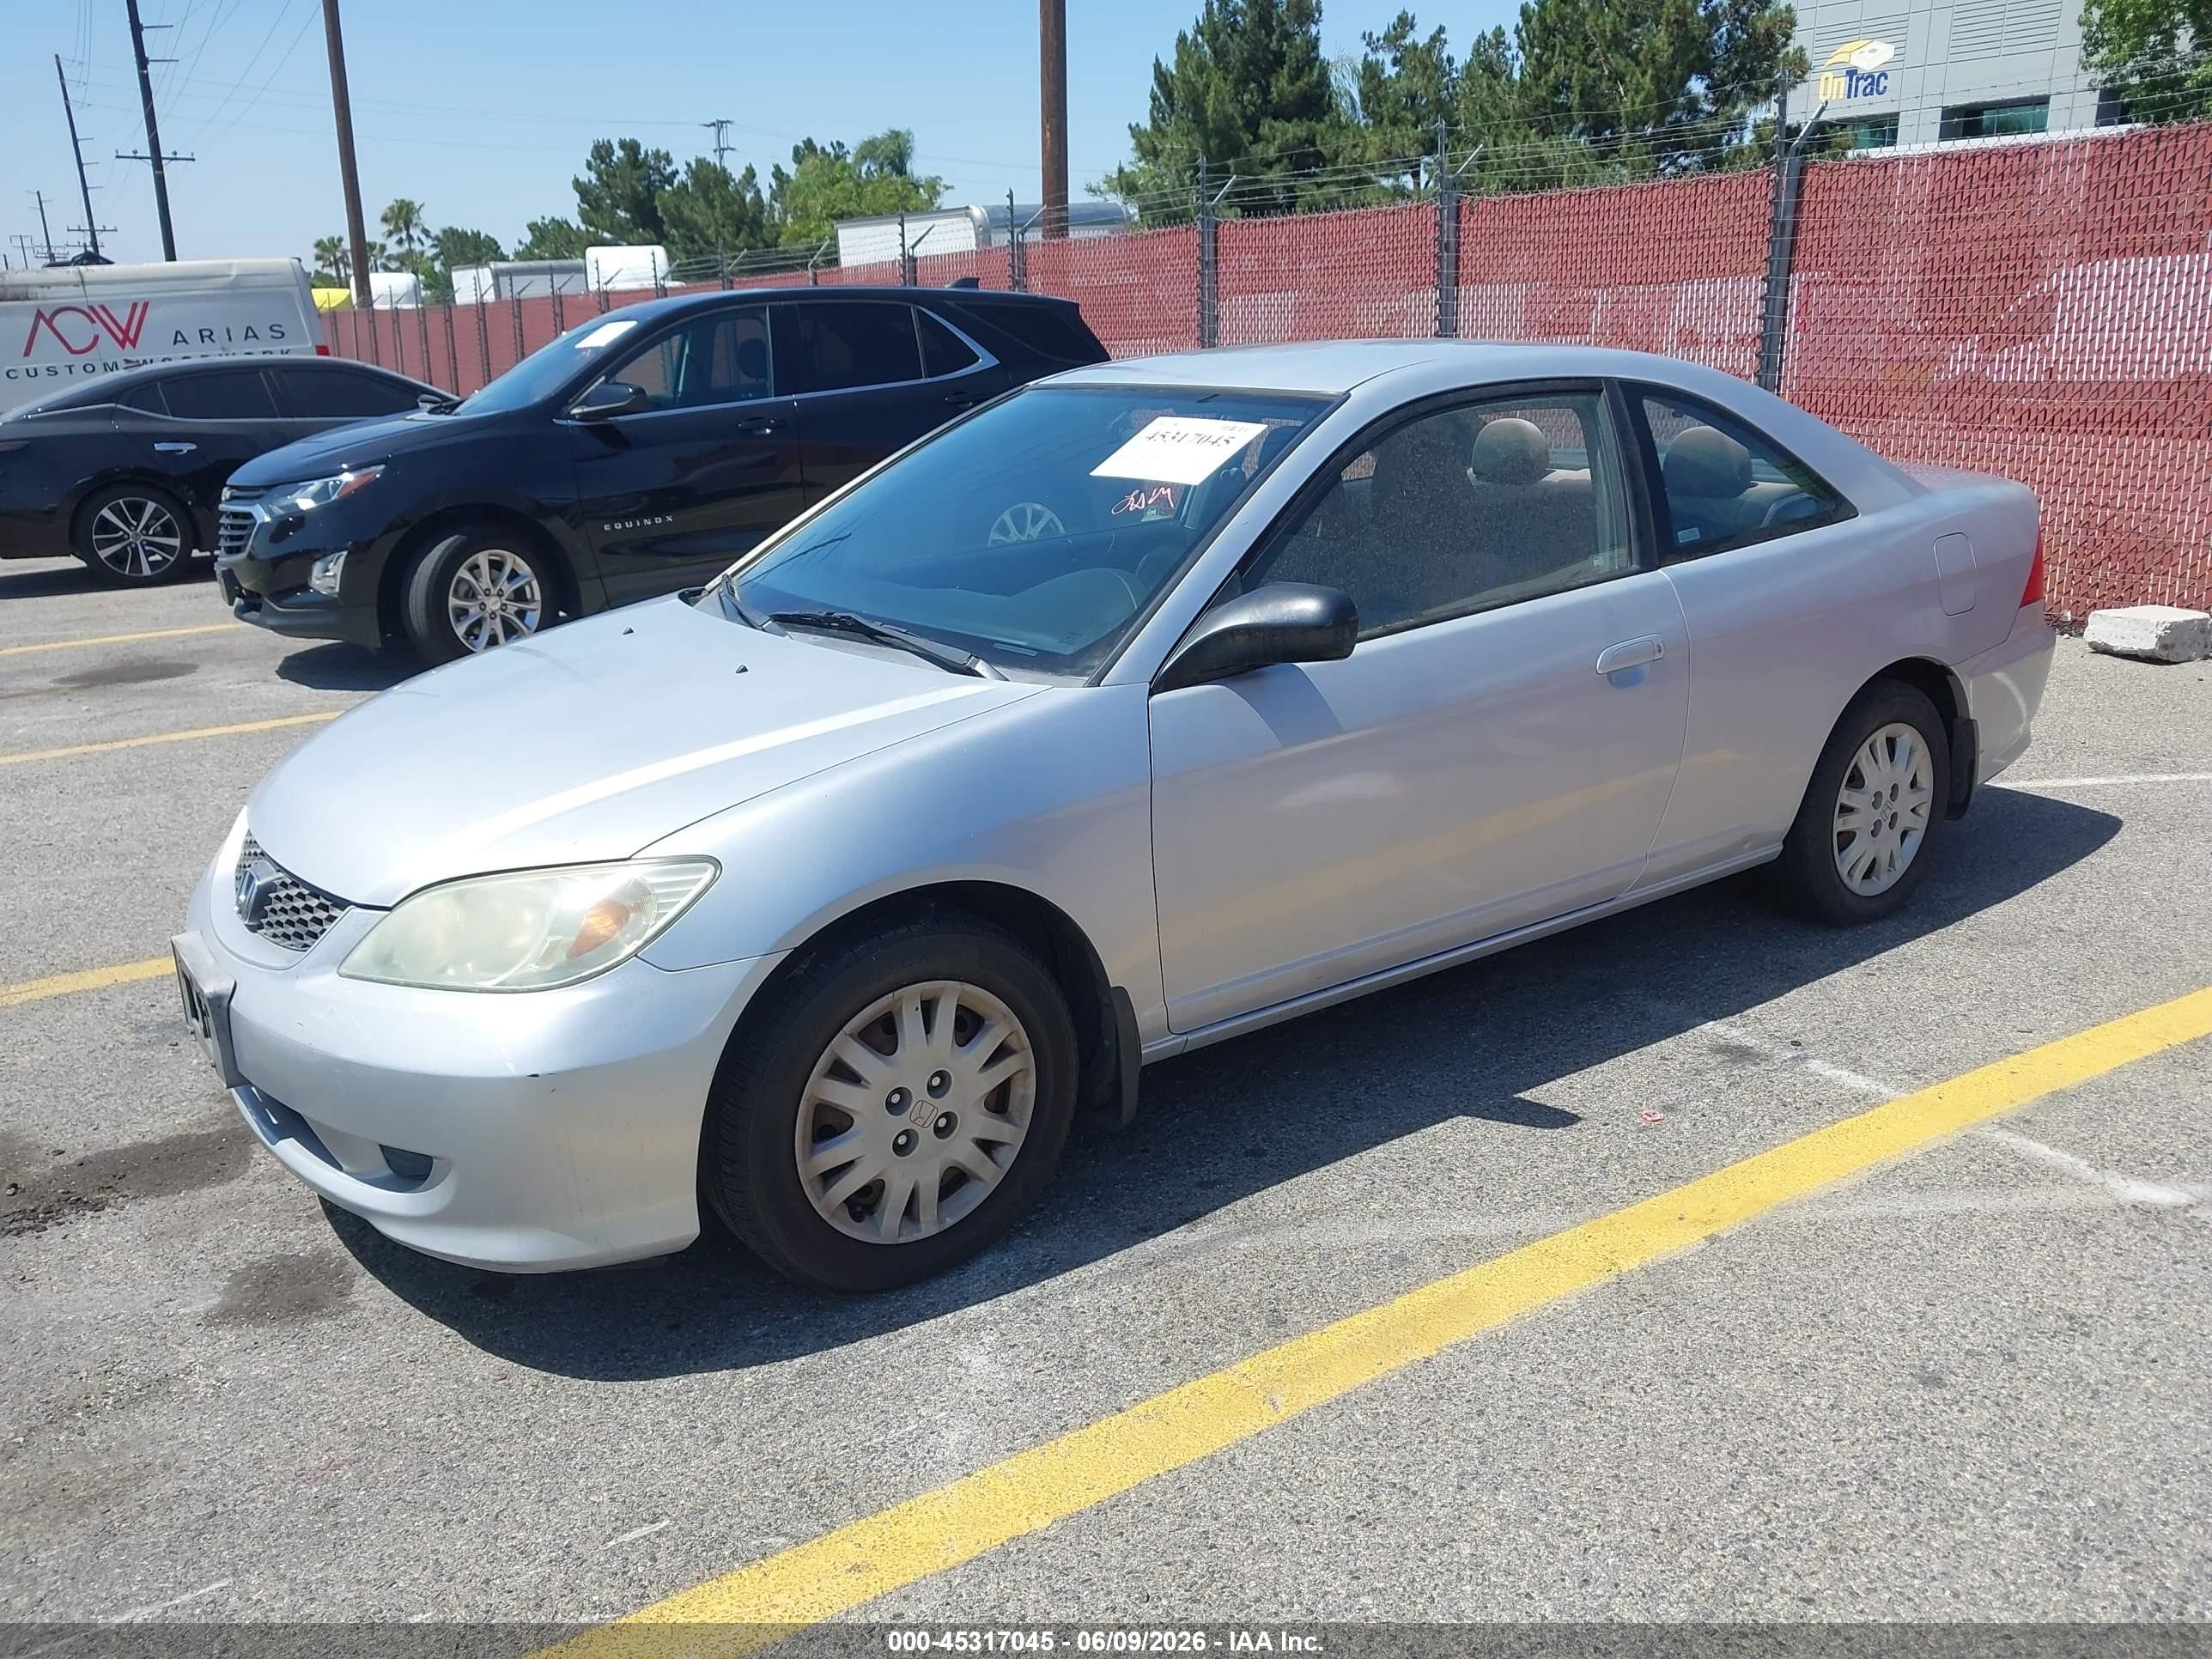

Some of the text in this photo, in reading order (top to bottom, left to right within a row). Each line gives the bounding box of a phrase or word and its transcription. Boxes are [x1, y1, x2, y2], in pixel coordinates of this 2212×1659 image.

[1820, 69, 1889, 100] OnTrac
[22, 301, 149, 357] ACW
[173, 324, 286, 346] ARIAS
[5, 361, 119, 380] CUSTOM
[1146, 431, 1236, 447] 45317045
[604, 515, 673, 531] EQUINOX
